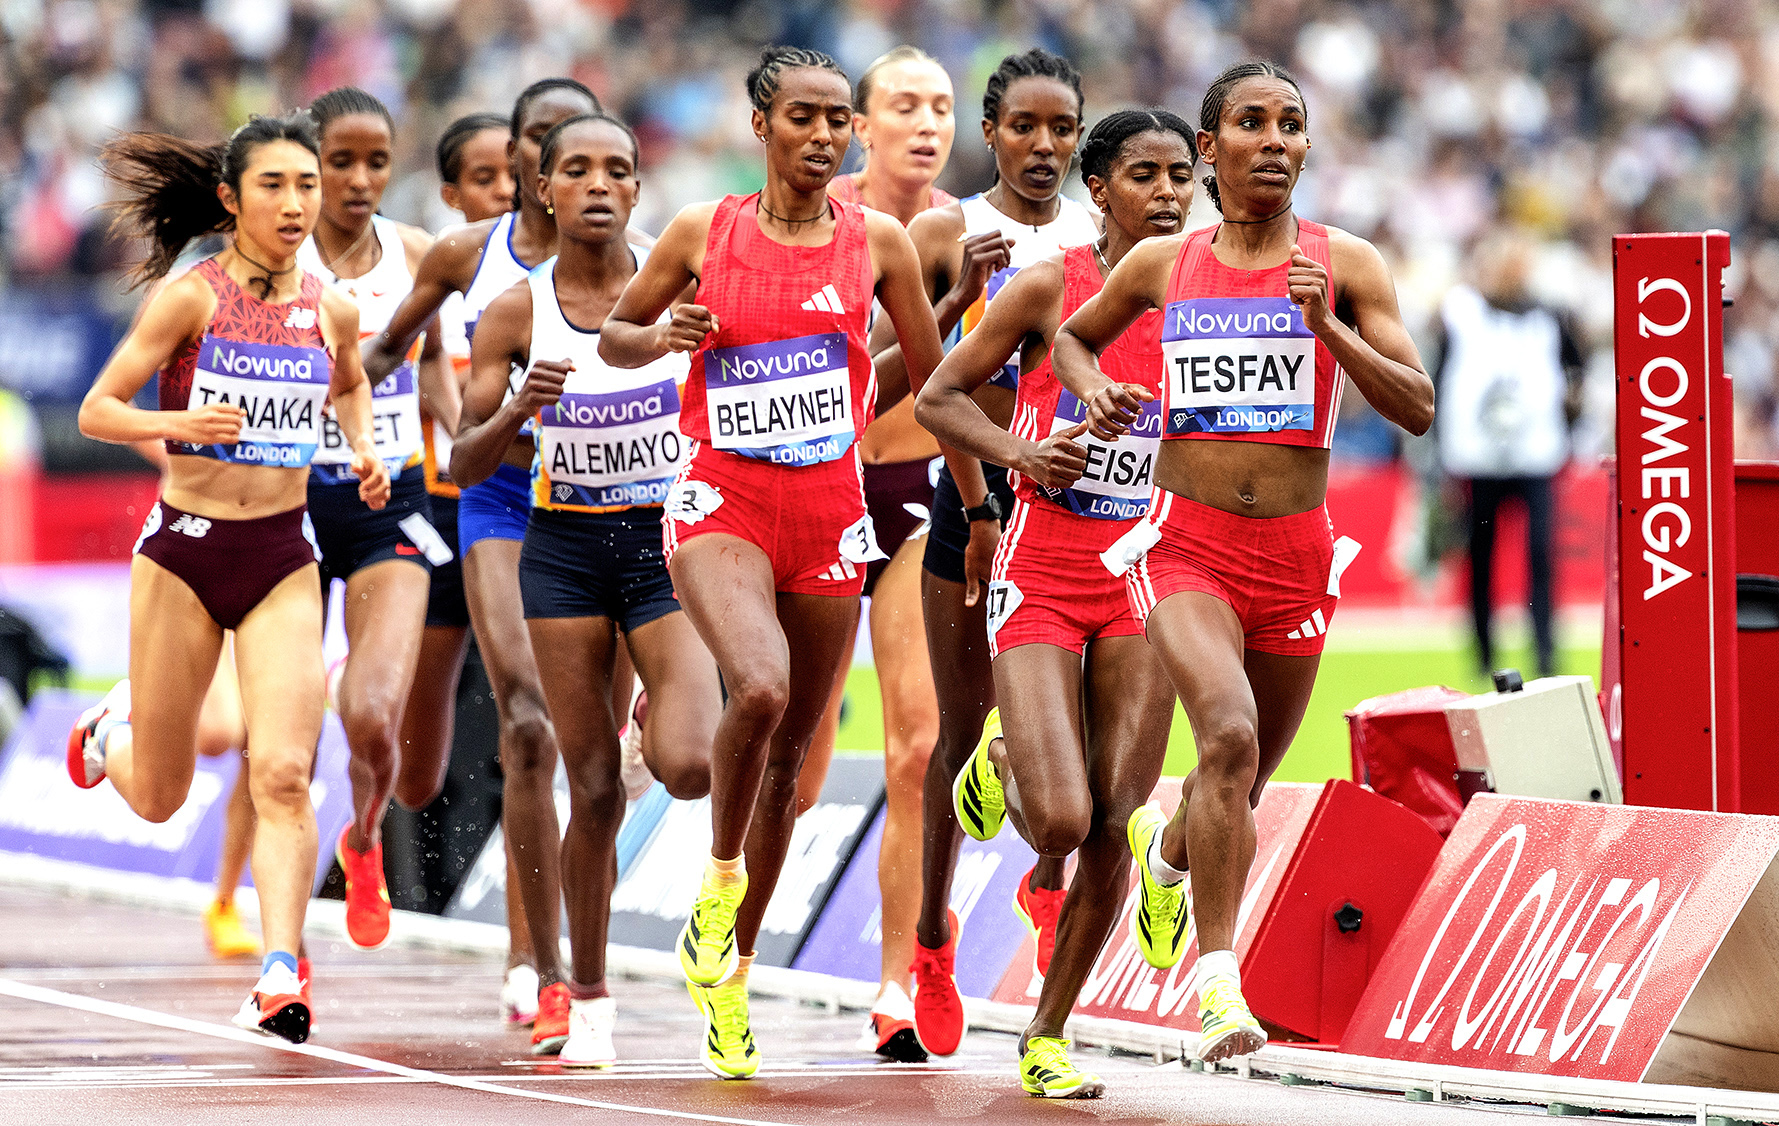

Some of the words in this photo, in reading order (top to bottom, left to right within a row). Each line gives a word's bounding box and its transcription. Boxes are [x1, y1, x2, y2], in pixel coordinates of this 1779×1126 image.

[1176, 308, 1291, 335] Novuna
[211, 345, 312, 380] Novuna
[721, 347, 828, 382] Novuna
[1175, 355, 1305, 394] TESFAY
[555, 395, 662, 425] Novuna
[717, 385, 845, 436] BELAYNEH
[1217, 411, 1293, 427] LONDON
[234, 444, 301, 462] LONDON
[552, 430, 680, 475] ALEMAYO
[770, 440, 840, 463] LONDON
[1082, 443, 1153, 487] EISA
[1638, 356, 1694, 601] OMEGA
[682, 490, 699, 512] 3
[857, 526, 870, 555] 3
[989, 587, 1009, 620] 17
[1451, 867, 1696, 1066] OMEGA
